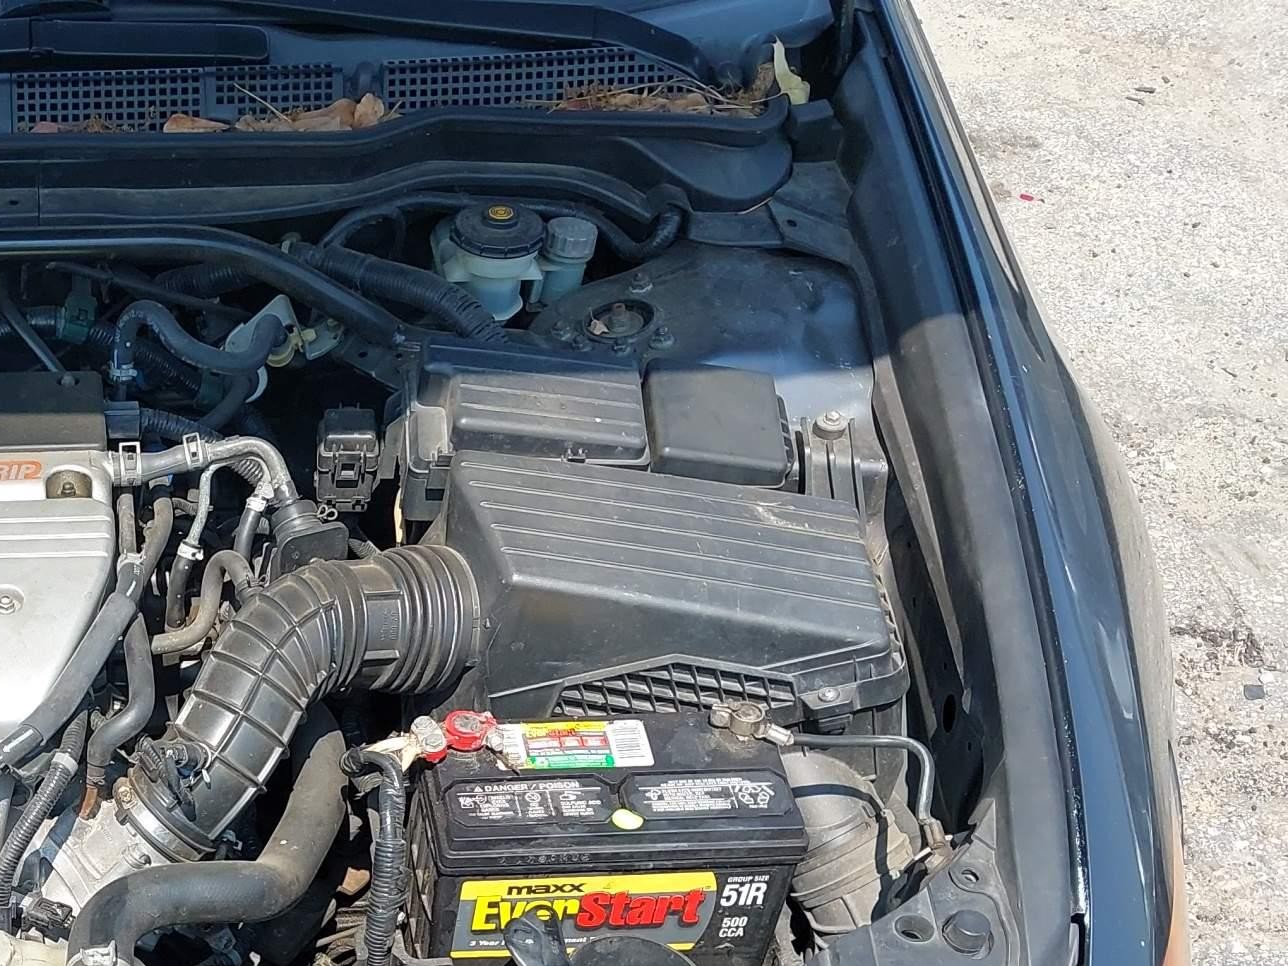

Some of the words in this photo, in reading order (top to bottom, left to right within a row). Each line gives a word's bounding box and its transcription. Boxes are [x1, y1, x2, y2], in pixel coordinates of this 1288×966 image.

[484, 784, 528, 792] DANGER
[539, 781, 580, 790] POISON
[507, 882, 586, 896] maxx
[720, 882, 768, 907] 51R
[722, 916, 748, 928] 500
[718, 927, 744, 938] CCA
